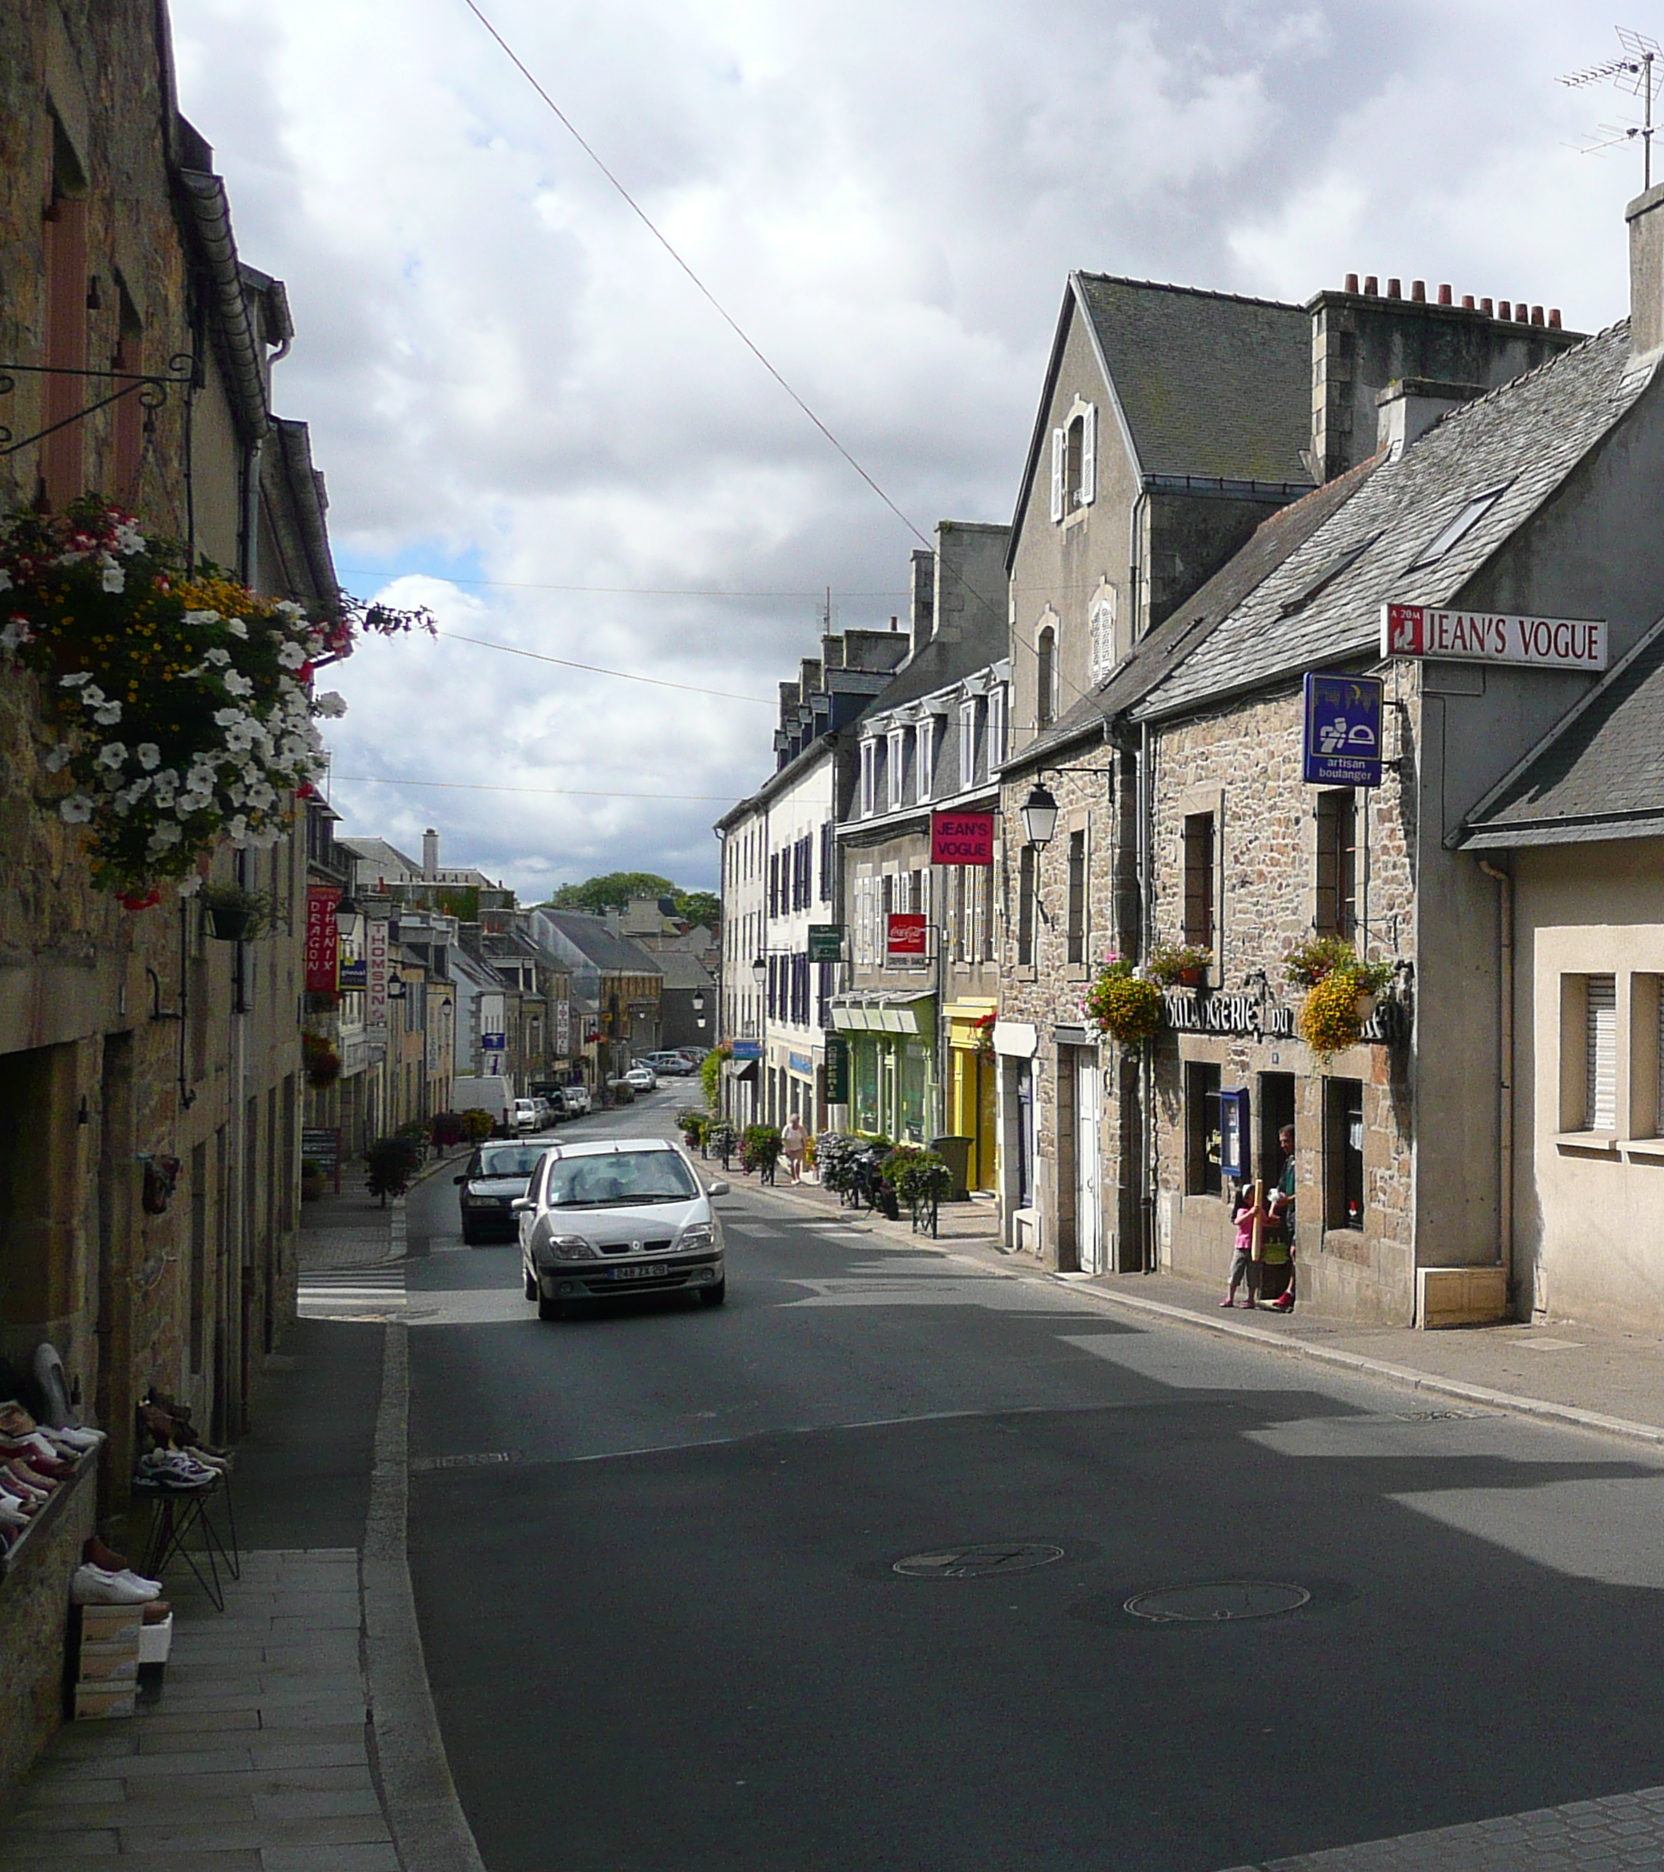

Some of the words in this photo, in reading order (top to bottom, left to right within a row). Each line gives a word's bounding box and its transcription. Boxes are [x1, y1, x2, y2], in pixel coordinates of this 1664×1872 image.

[1428, 613, 1506, 653] JEAN'S
[1519, 620, 1599, 660] VOGUE
[1319, 767, 1372, 781] boulanger
[1327, 758, 1366, 769] artisan
[936, 821, 989, 837] JEAN'S
[937, 842, 987, 857] VOGUE
[308, 901, 321, 971] DRAGON
[371, 923, 386, 1006] THOMSON
[1164, 995, 1259, 1032] OULANGERIE
